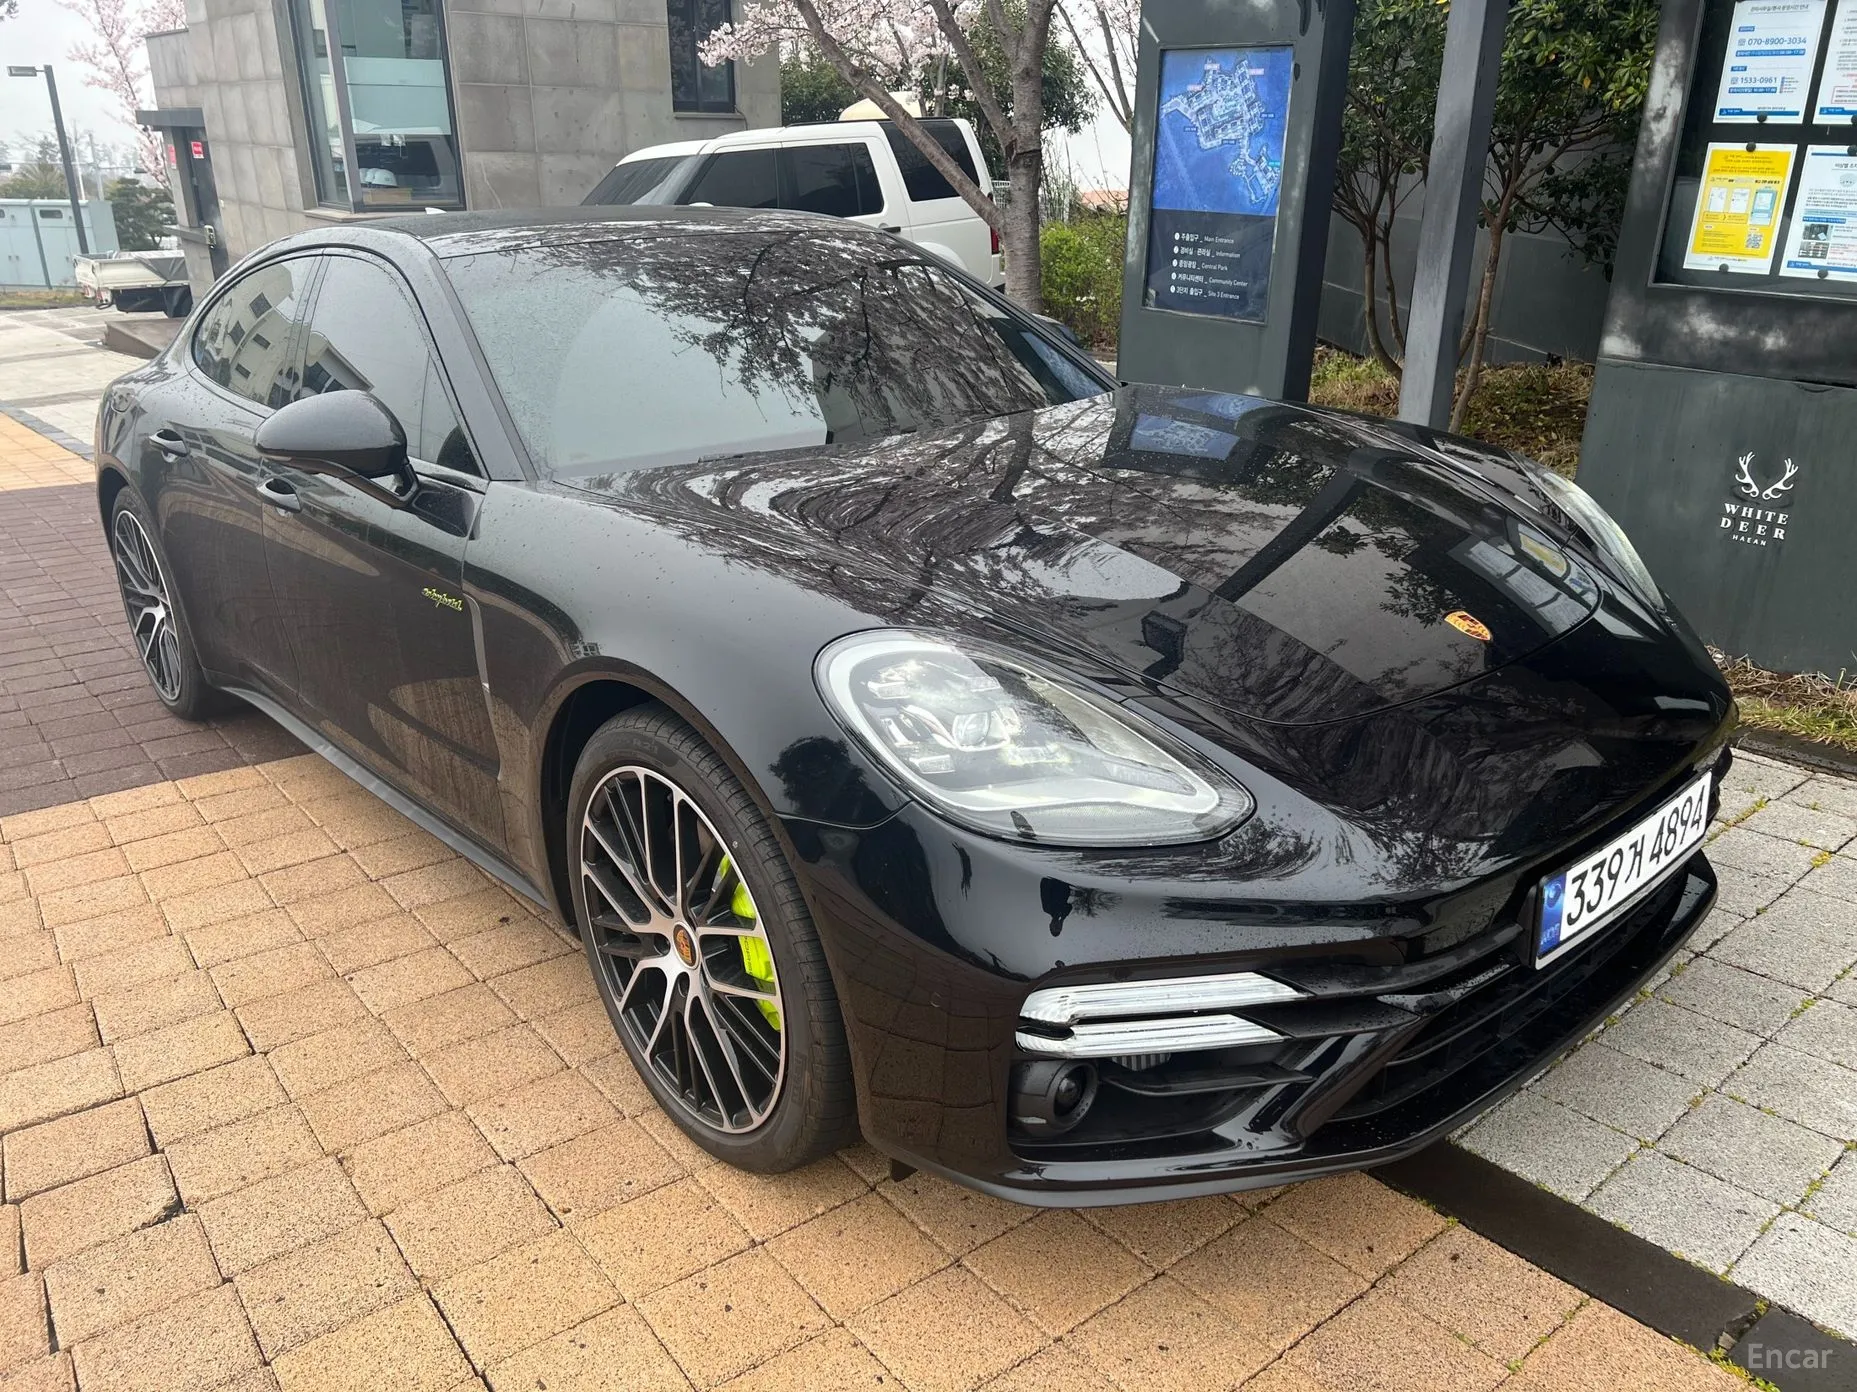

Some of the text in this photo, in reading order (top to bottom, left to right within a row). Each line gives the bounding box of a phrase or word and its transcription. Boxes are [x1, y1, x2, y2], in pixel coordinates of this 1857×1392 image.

[1747, 37, 1807, 46] 070-8900-3034
[1740, 76, 1777, 84] 1533-0961
[1181, 233, 1199, 242] 주출입구
[1216, 250, 1240, 258] Information
[1177, 273, 1204, 283] 커뮤니티센터
[1209, 277, 1233, 286] Community
[1190, 287, 1203, 296] 출입구
[1725, 503, 1788, 525] WHITE
[1720, 517, 1785, 539] DEER
[1732, 534, 1767, 546] HAEAN
[421, 588, 462, 611] e-hybrid
[1649, 785, 1705, 865] 4894
